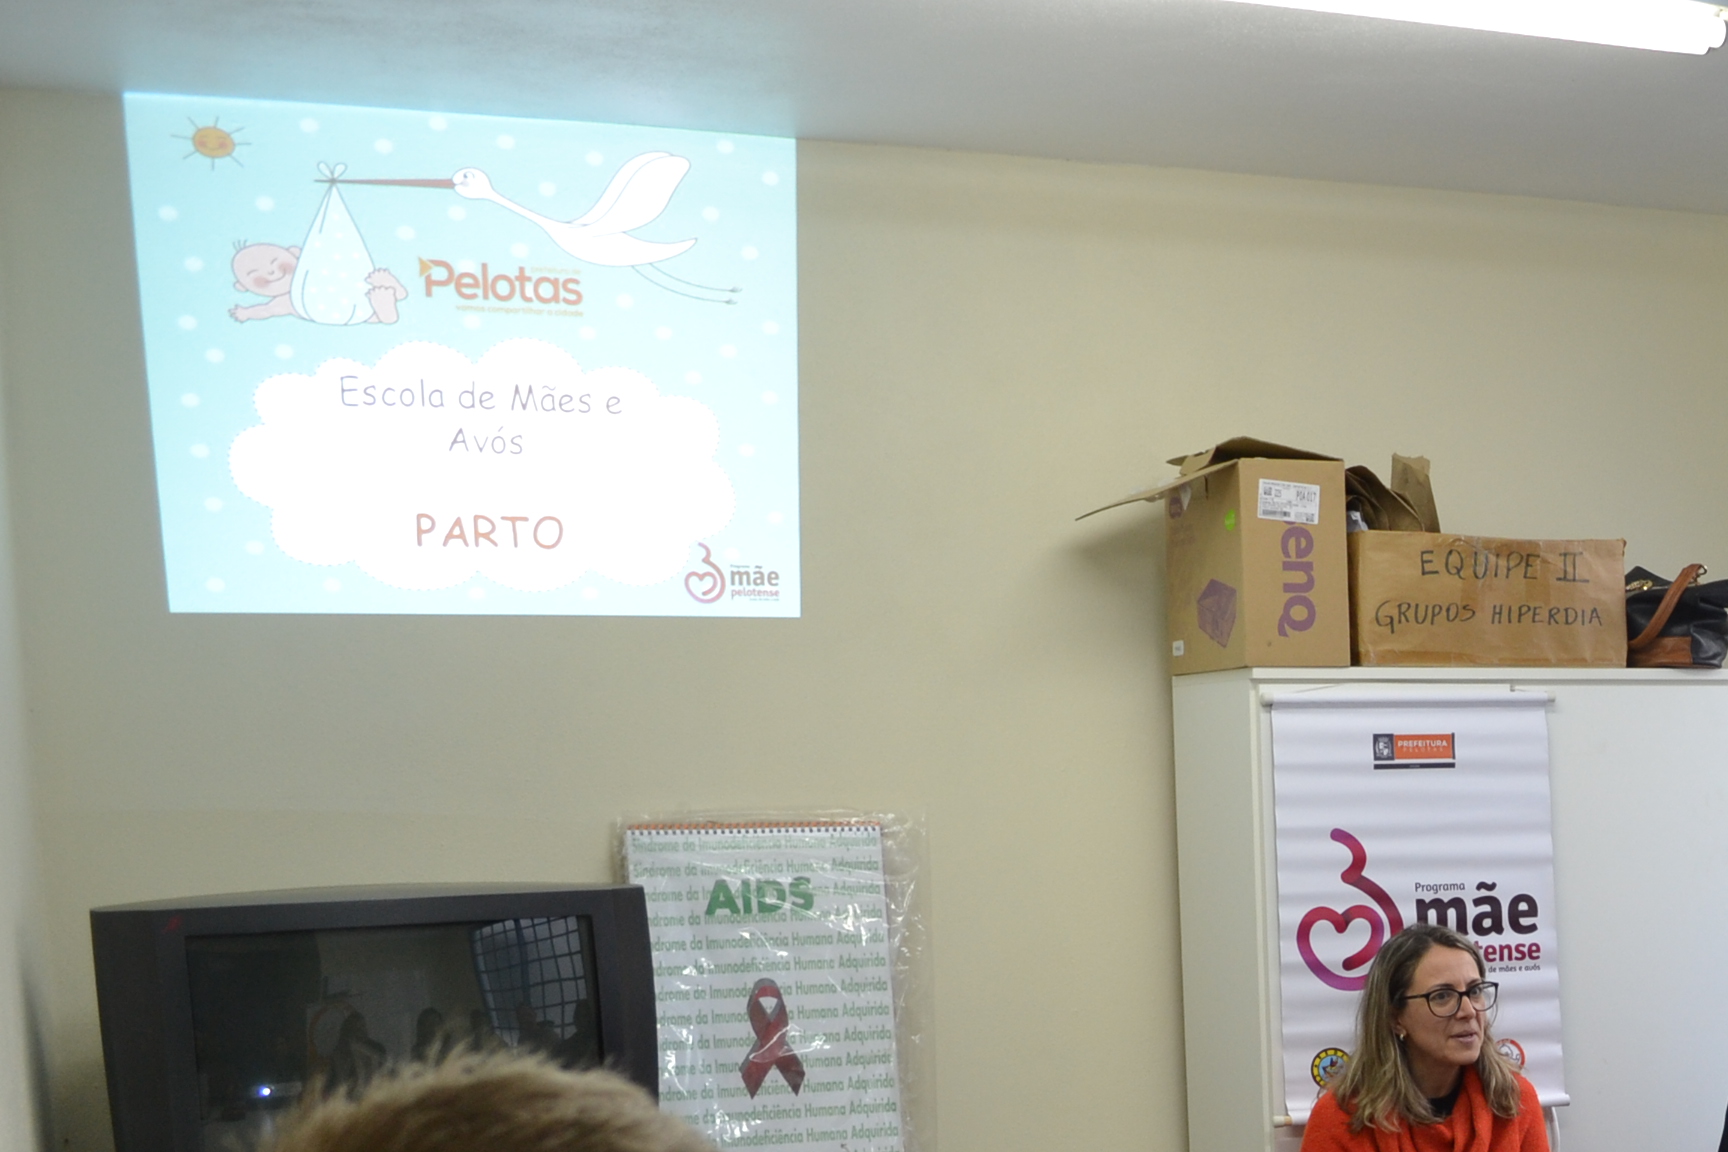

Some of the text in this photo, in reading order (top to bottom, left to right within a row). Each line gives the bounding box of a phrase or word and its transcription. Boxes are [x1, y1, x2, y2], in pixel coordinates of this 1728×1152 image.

[424, 259, 583, 306] Pelotas
[340, 375, 622, 414] Escola de Mães e
[448, 425, 523, 455] Avós
[416, 513, 564, 550] PARTO
[730, 565, 780, 587] mãe
[1420, 549, 1590, 583] EQUIPE II
[1278, 521, 1316, 638] enQ
[731, 587, 780, 600] pelotense
[1375, 600, 1603, 634] GRUPOS HIPERDIA
[1397, 739, 1448, 748] PREFEITURA
[685, 861, 697, 876] da
[645, 887, 683, 901] ndrome
[687, 886, 699, 901] da
[705, 876, 814, 916] AIDS
[1414, 882, 1465, 894] Programa
[688, 911, 701, 925] da
[1415, 881, 1538, 936] mãe
[652, 937, 687, 951] drome
[690, 936, 703, 950] da
[792, 933, 833, 946] Humana
[837, 930, 884, 948] Adqurida
[1474, 941, 1541, 962] tense
[839, 954, 886, 972] Adquirida
[657, 987, 690, 1001] drome
[694, 985, 706, 999] da
[796, 982, 837, 995] Humana
[841, 979, 888, 996] Adquirida
[658, 1012, 692, 1026] drome
[696, 1010, 708, 1024] da
[798, 1006, 839, 1019] Humana
[843, 1003, 889, 1020] Adquirida
[698, 1035, 710, 1049] da
[844, 1027, 891, 1044] Adquirida
[801, 1055, 842, 1068] Humana
[660, 1087, 697, 1100] ndrome
[701, 1084, 714, 1098] da
[803, 1079, 844, 1092] Humana
[848, 1076, 895, 1093] Adquirida
[805, 1104, 846, 1116] Humana
[850, 1100, 897, 1117] Adquirida
[807, 1128, 848, 1141] Humana
[852, 1124, 898, 1142] Adquirida
